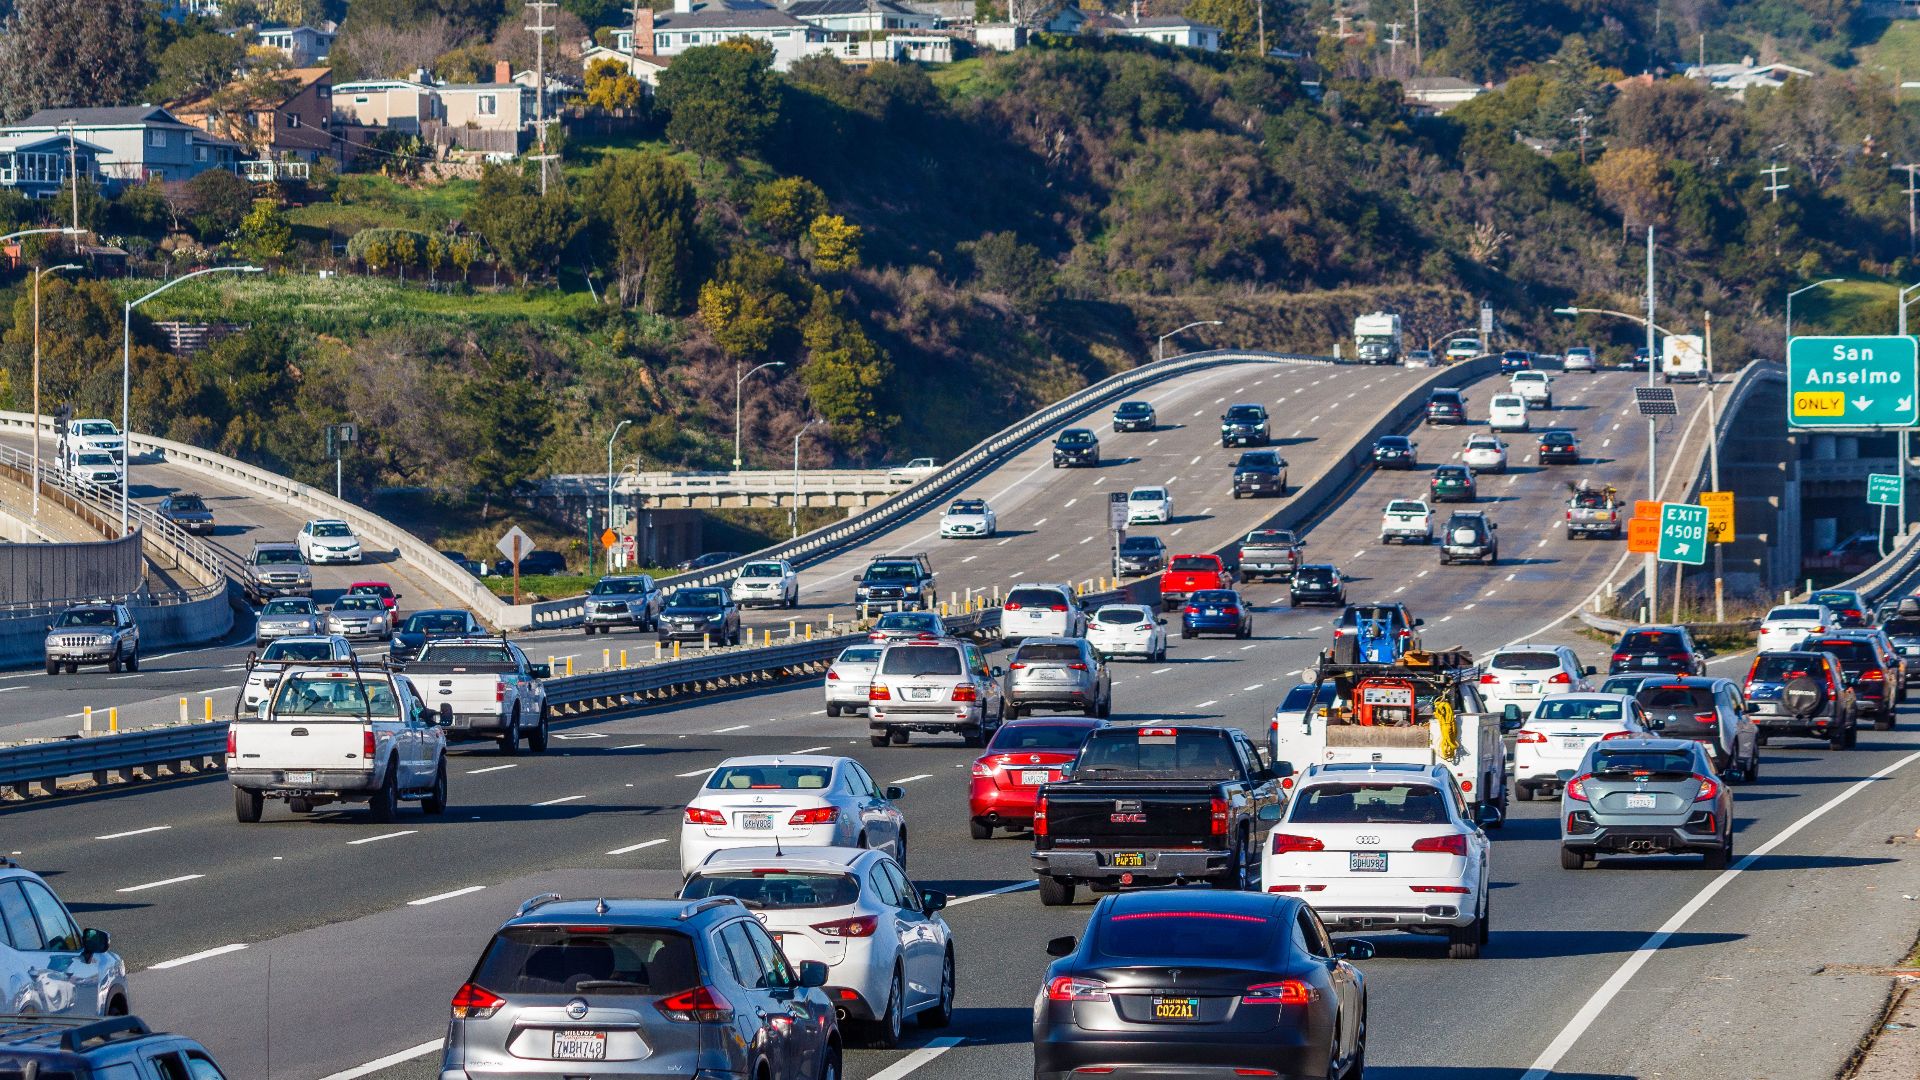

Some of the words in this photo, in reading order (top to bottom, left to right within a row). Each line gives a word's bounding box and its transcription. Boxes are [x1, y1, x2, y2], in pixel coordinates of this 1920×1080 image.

[1833, 344, 1873, 361] San
[1805, 368, 1901, 384] Anselmo
[1798, 398, 1840, 410] ONLY
[1667, 508, 1702, 522] EXIT
[1665, 525, 1702, 539] 450B
[1111, 813, 1147, 823] GMC
[556, 1041, 602, 1054] 7WBH748
